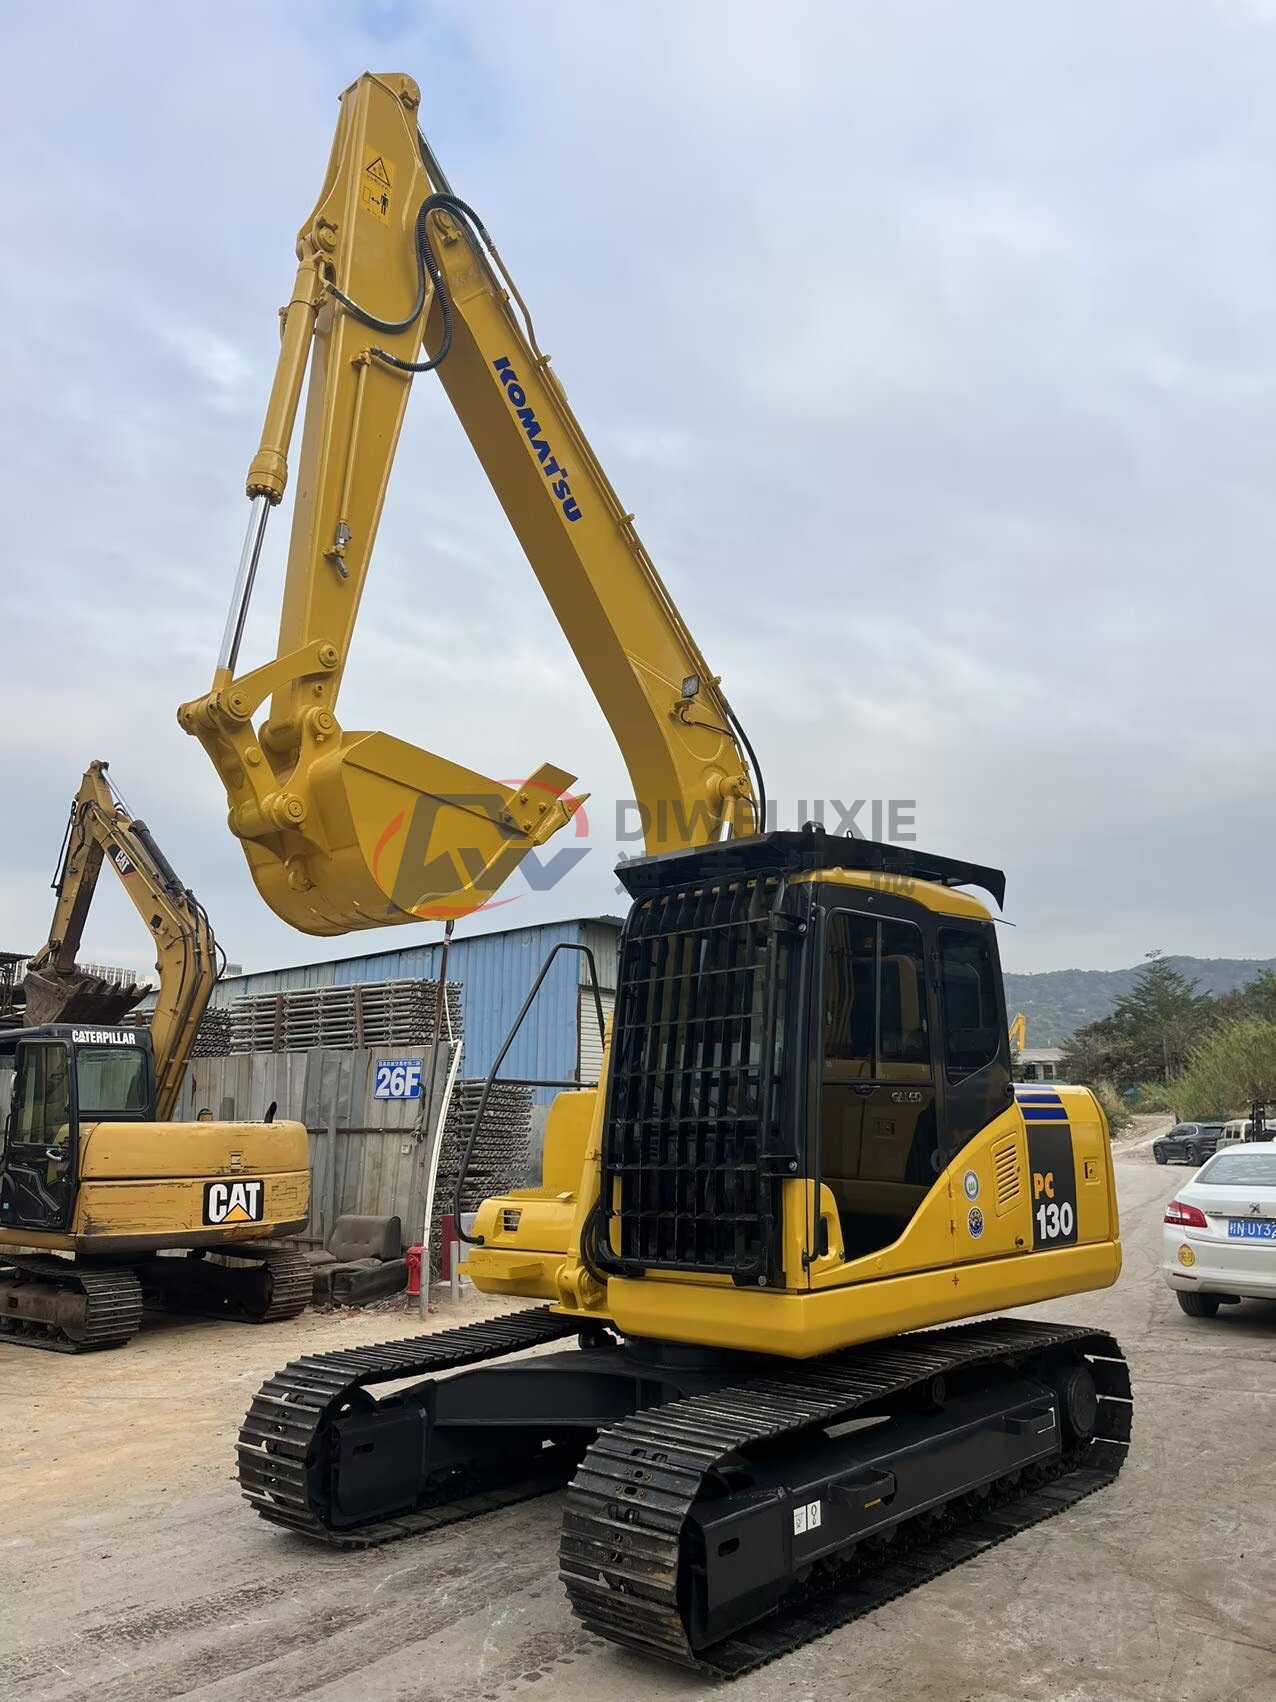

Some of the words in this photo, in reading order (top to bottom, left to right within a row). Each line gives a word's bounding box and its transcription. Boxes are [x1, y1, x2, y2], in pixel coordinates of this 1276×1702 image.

[493, 356, 583, 522] KOMATSU
[115, 850, 130, 873] CAT
[72, 1029, 136, 1045] CATERPILLAR
[375, 1066, 421, 1096] 26F
[1033, 1172, 1055, 1200] PC
[208, 1182, 261, 1223] CAT
[1036, 1201, 1074, 1240] 130
